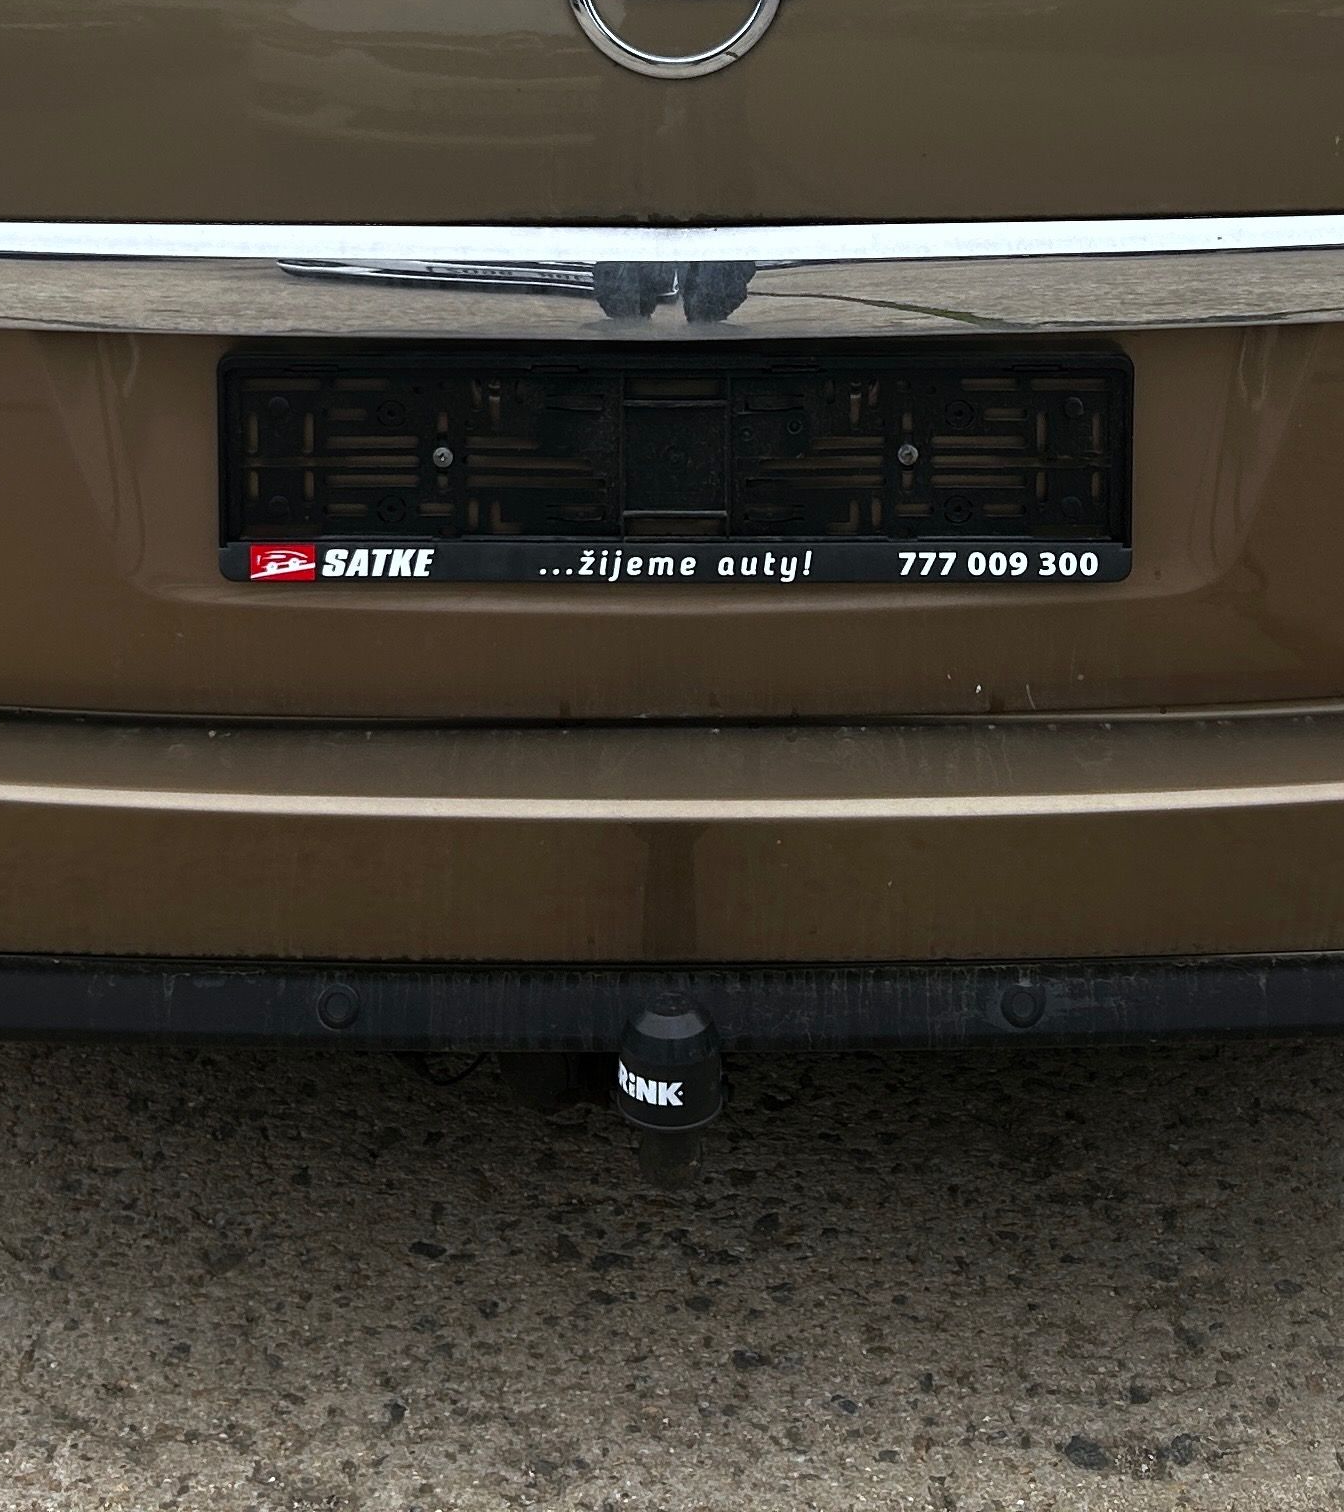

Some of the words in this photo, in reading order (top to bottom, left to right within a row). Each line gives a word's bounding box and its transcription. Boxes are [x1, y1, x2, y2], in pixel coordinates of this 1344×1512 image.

[321, 548, 435, 577] SATKE
[539, 549, 697, 582] ...žijeme
[717, 550, 813, 583] auty!
[898, 551, 957, 576] 777
[967, 551, 1028, 576] 009
[1038, 551, 1099, 576] 300
